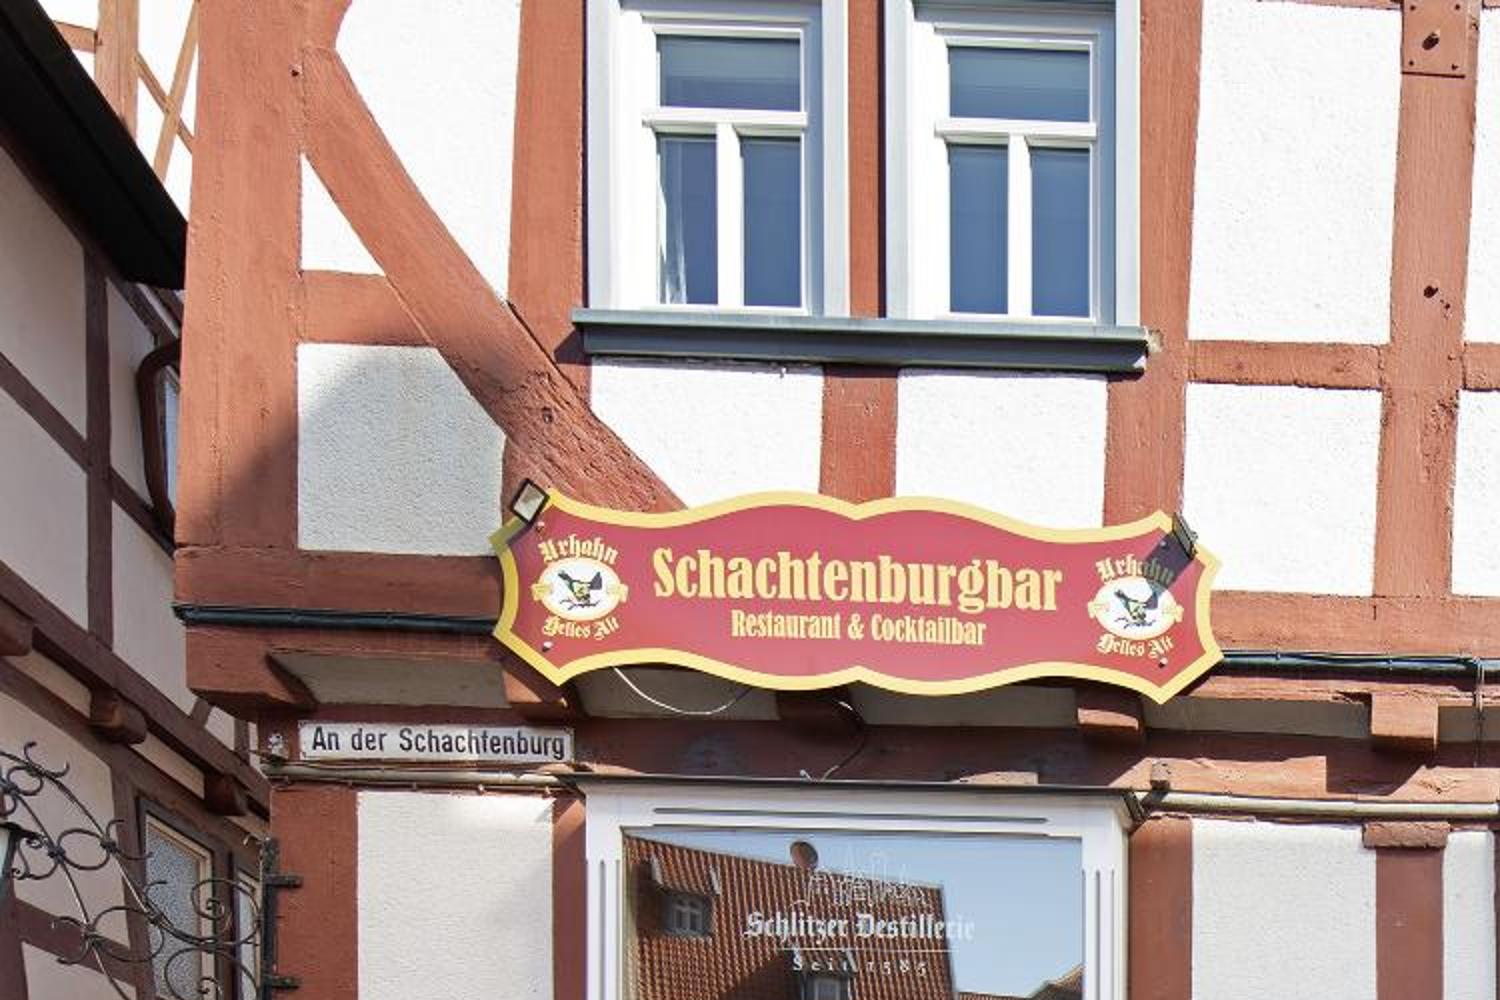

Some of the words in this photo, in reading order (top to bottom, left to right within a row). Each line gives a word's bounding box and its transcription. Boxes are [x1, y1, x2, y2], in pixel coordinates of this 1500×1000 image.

[538, 533, 619, 563] Urhahn
[652, 547, 1063, 614] Schachtenburgbar
[1095, 553, 1175, 585] Urhahn
[731, 609, 841, 640] Restaurant
[847, 613, 865, 640] &
[871, 613, 987, 645] Cocktailbar
[312, 726, 340, 751] An
[351, 727, 388, 752] der
[398, 727, 566, 761] Schachtenburg
[743, 910, 849, 945] Schlitzer
[855, 912, 976, 941] Destillerie
